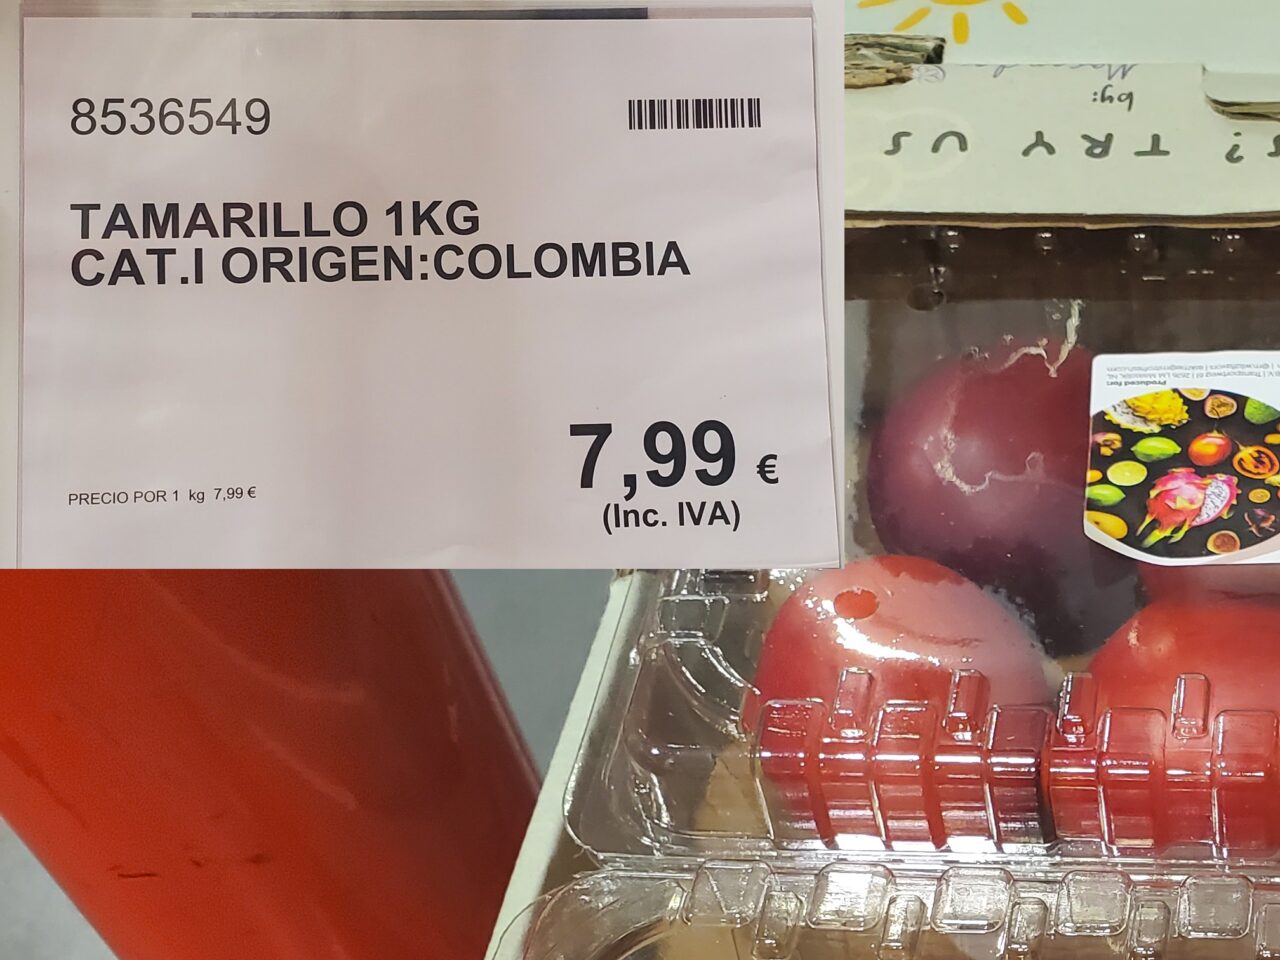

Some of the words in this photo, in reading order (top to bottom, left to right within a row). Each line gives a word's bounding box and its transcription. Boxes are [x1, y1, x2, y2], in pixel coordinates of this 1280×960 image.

[70, 97, 271, 137] 8536549
[1092, 87, 1134, 111] by:
[885, 131, 968, 156] US
[1021, 132, 1171, 159] TRY
[70, 201, 369, 240] TAMARILLO
[385, 199, 481, 237] 1KG
[70, 246, 204, 286] CAT.I
[221, 240, 691, 284] ORIGEN:COLOMBIA
[568, 420, 737, 500] 7,99
[756, 454, 780, 485] €
[68, 491, 129, 506] PRECIO
[133, 490, 168, 503] POR
[172, 489, 179, 502] 1
[188, 489, 205, 504] kg
[214, 487, 244, 501] 7,99
[247, 486, 257, 499] €
[602, 503, 668, 536] (Inc.
[677, 500, 741, 531] IVA)
